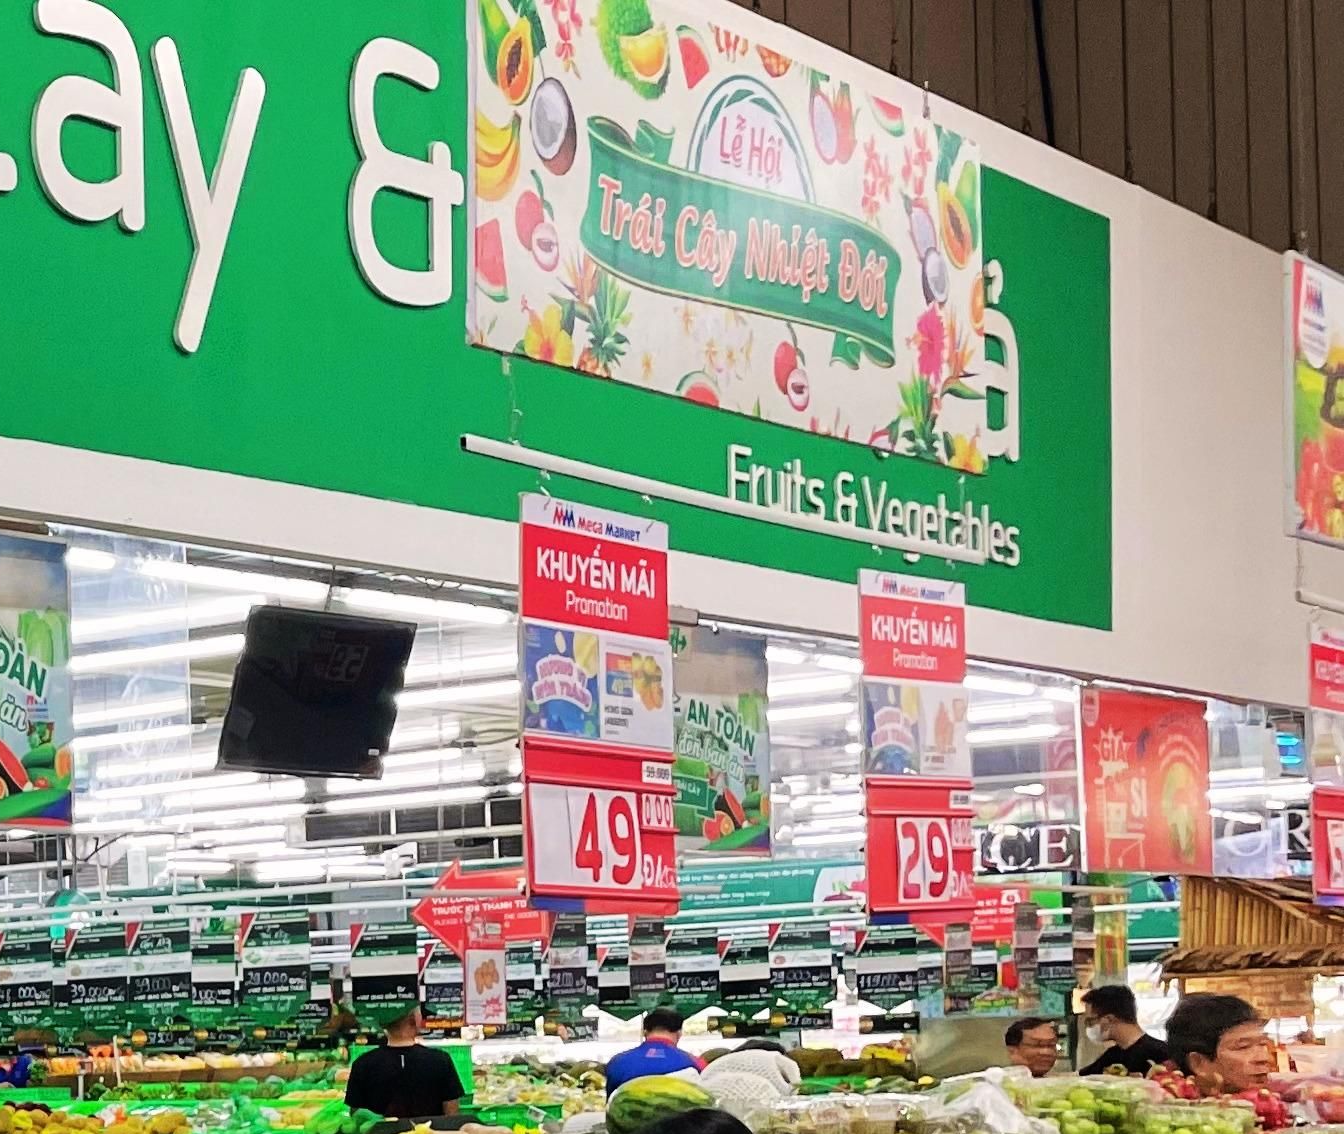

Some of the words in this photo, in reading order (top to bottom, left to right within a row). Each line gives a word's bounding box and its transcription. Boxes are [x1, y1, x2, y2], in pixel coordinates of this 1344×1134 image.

[348, 36, 465, 308] &
[748, 125, 784, 190] Hội
[598, 174, 666, 258] Trái
[674, 206, 737, 287] Cây
[745, 218, 830, 301] Nhiệt
[726, 443, 826, 524] Fruits
[835, 472, 859, 525] &
[862, 475, 1021, 567] Vegetables
[536, 543, 616, 590] KHUYẾN
[621, 559, 656, 599] MÃI
[565, 590, 628, 622] Promotion
[870, 606, 928, 646] KHUYẾN
[931, 616, 957, 648] MÃI
[687, 699, 709, 725] AN
[715, 702, 755, 758] TOÀN
[575, 792, 637, 886] 49
[900, 821, 950, 900] 29
